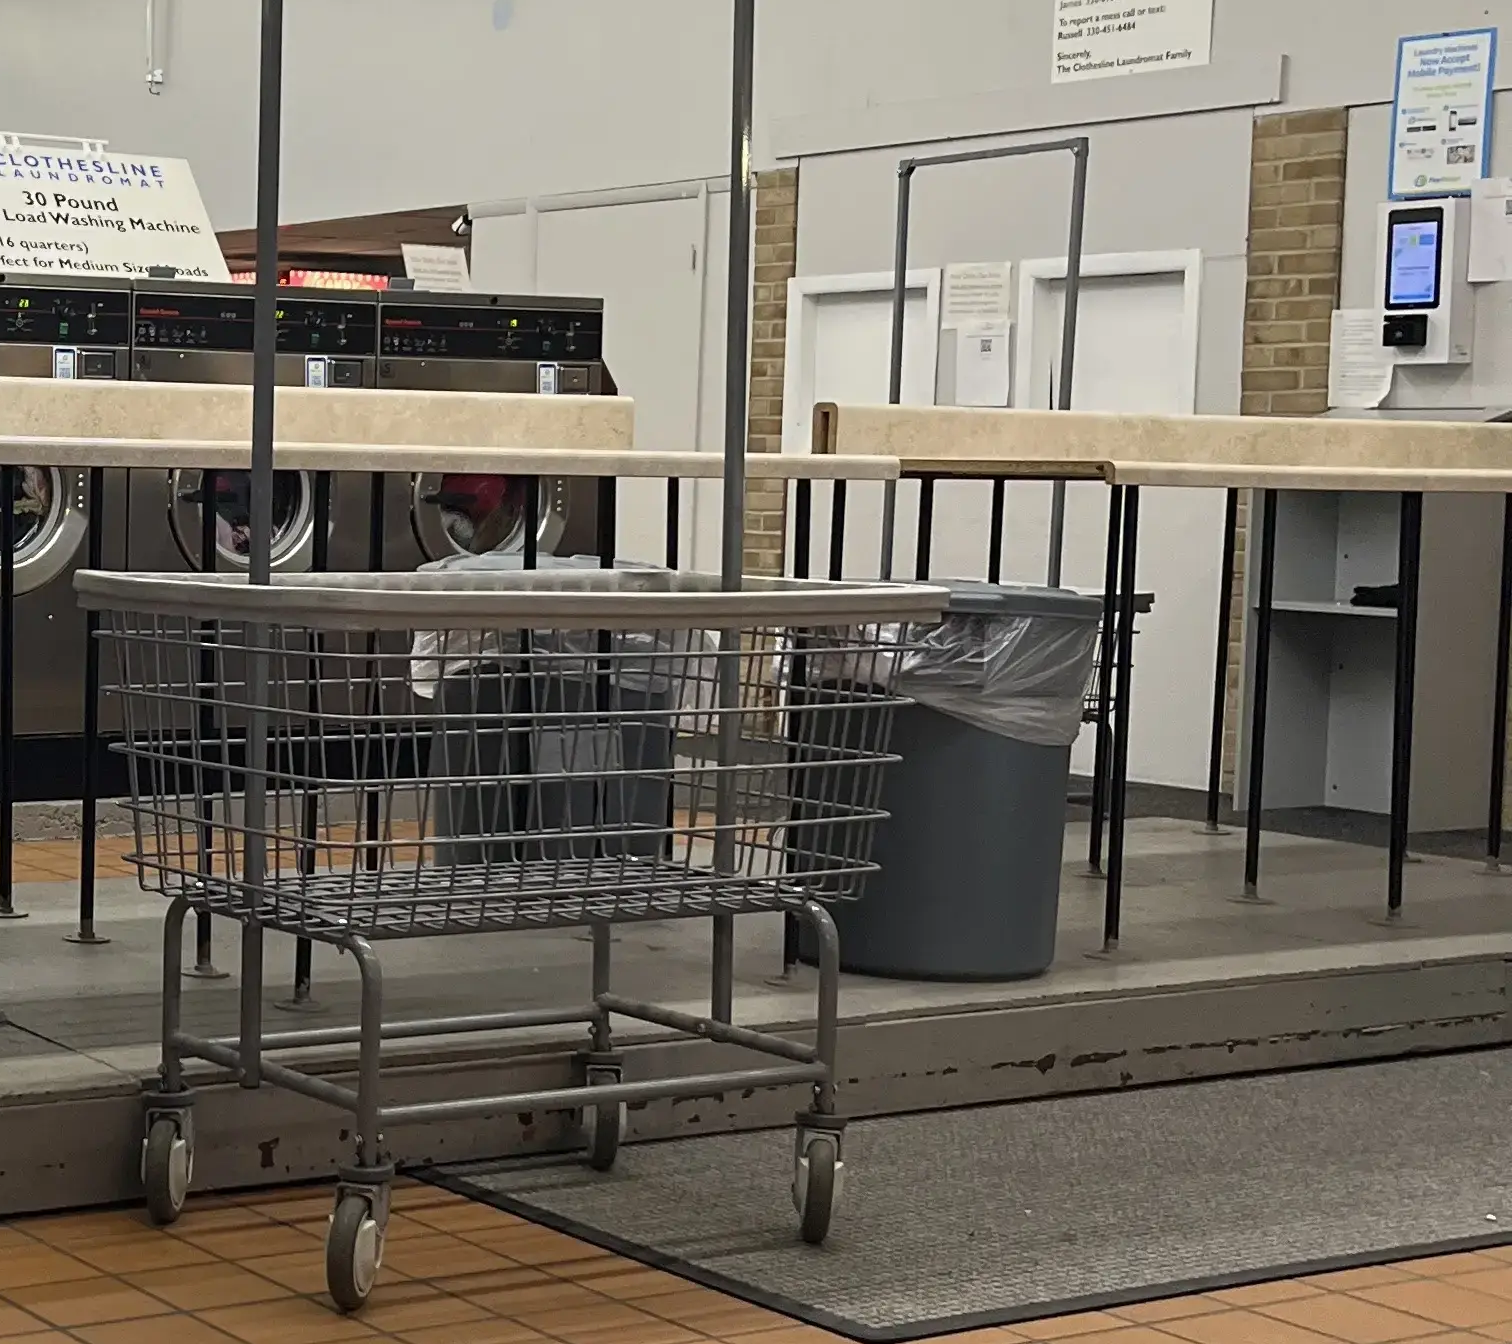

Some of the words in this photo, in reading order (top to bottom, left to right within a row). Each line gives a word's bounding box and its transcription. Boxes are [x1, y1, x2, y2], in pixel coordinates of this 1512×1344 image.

[1059, 18, 1067, 27] To
[1122, 8, 1136, 17] call
[1057, 65, 1071, 74] The
[1073, 61, 1114, 72] Clothesline
[1116, 53, 1164, 66] Laundromat
[1165, 48, 1192, 60] Family
[21, 190, 47, 207] 30
[53, 192, 119, 212] Pound
[2, 208, 47, 223] Load
[48, 211, 127, 233] Washing
[128, 217, 201, 234] Machine
[19, 239, 90, 255] quarters)
[32, 255, 55, 269] for
[58, 258, 120, 273] Medium
[164, 264, 209, 278] oads
